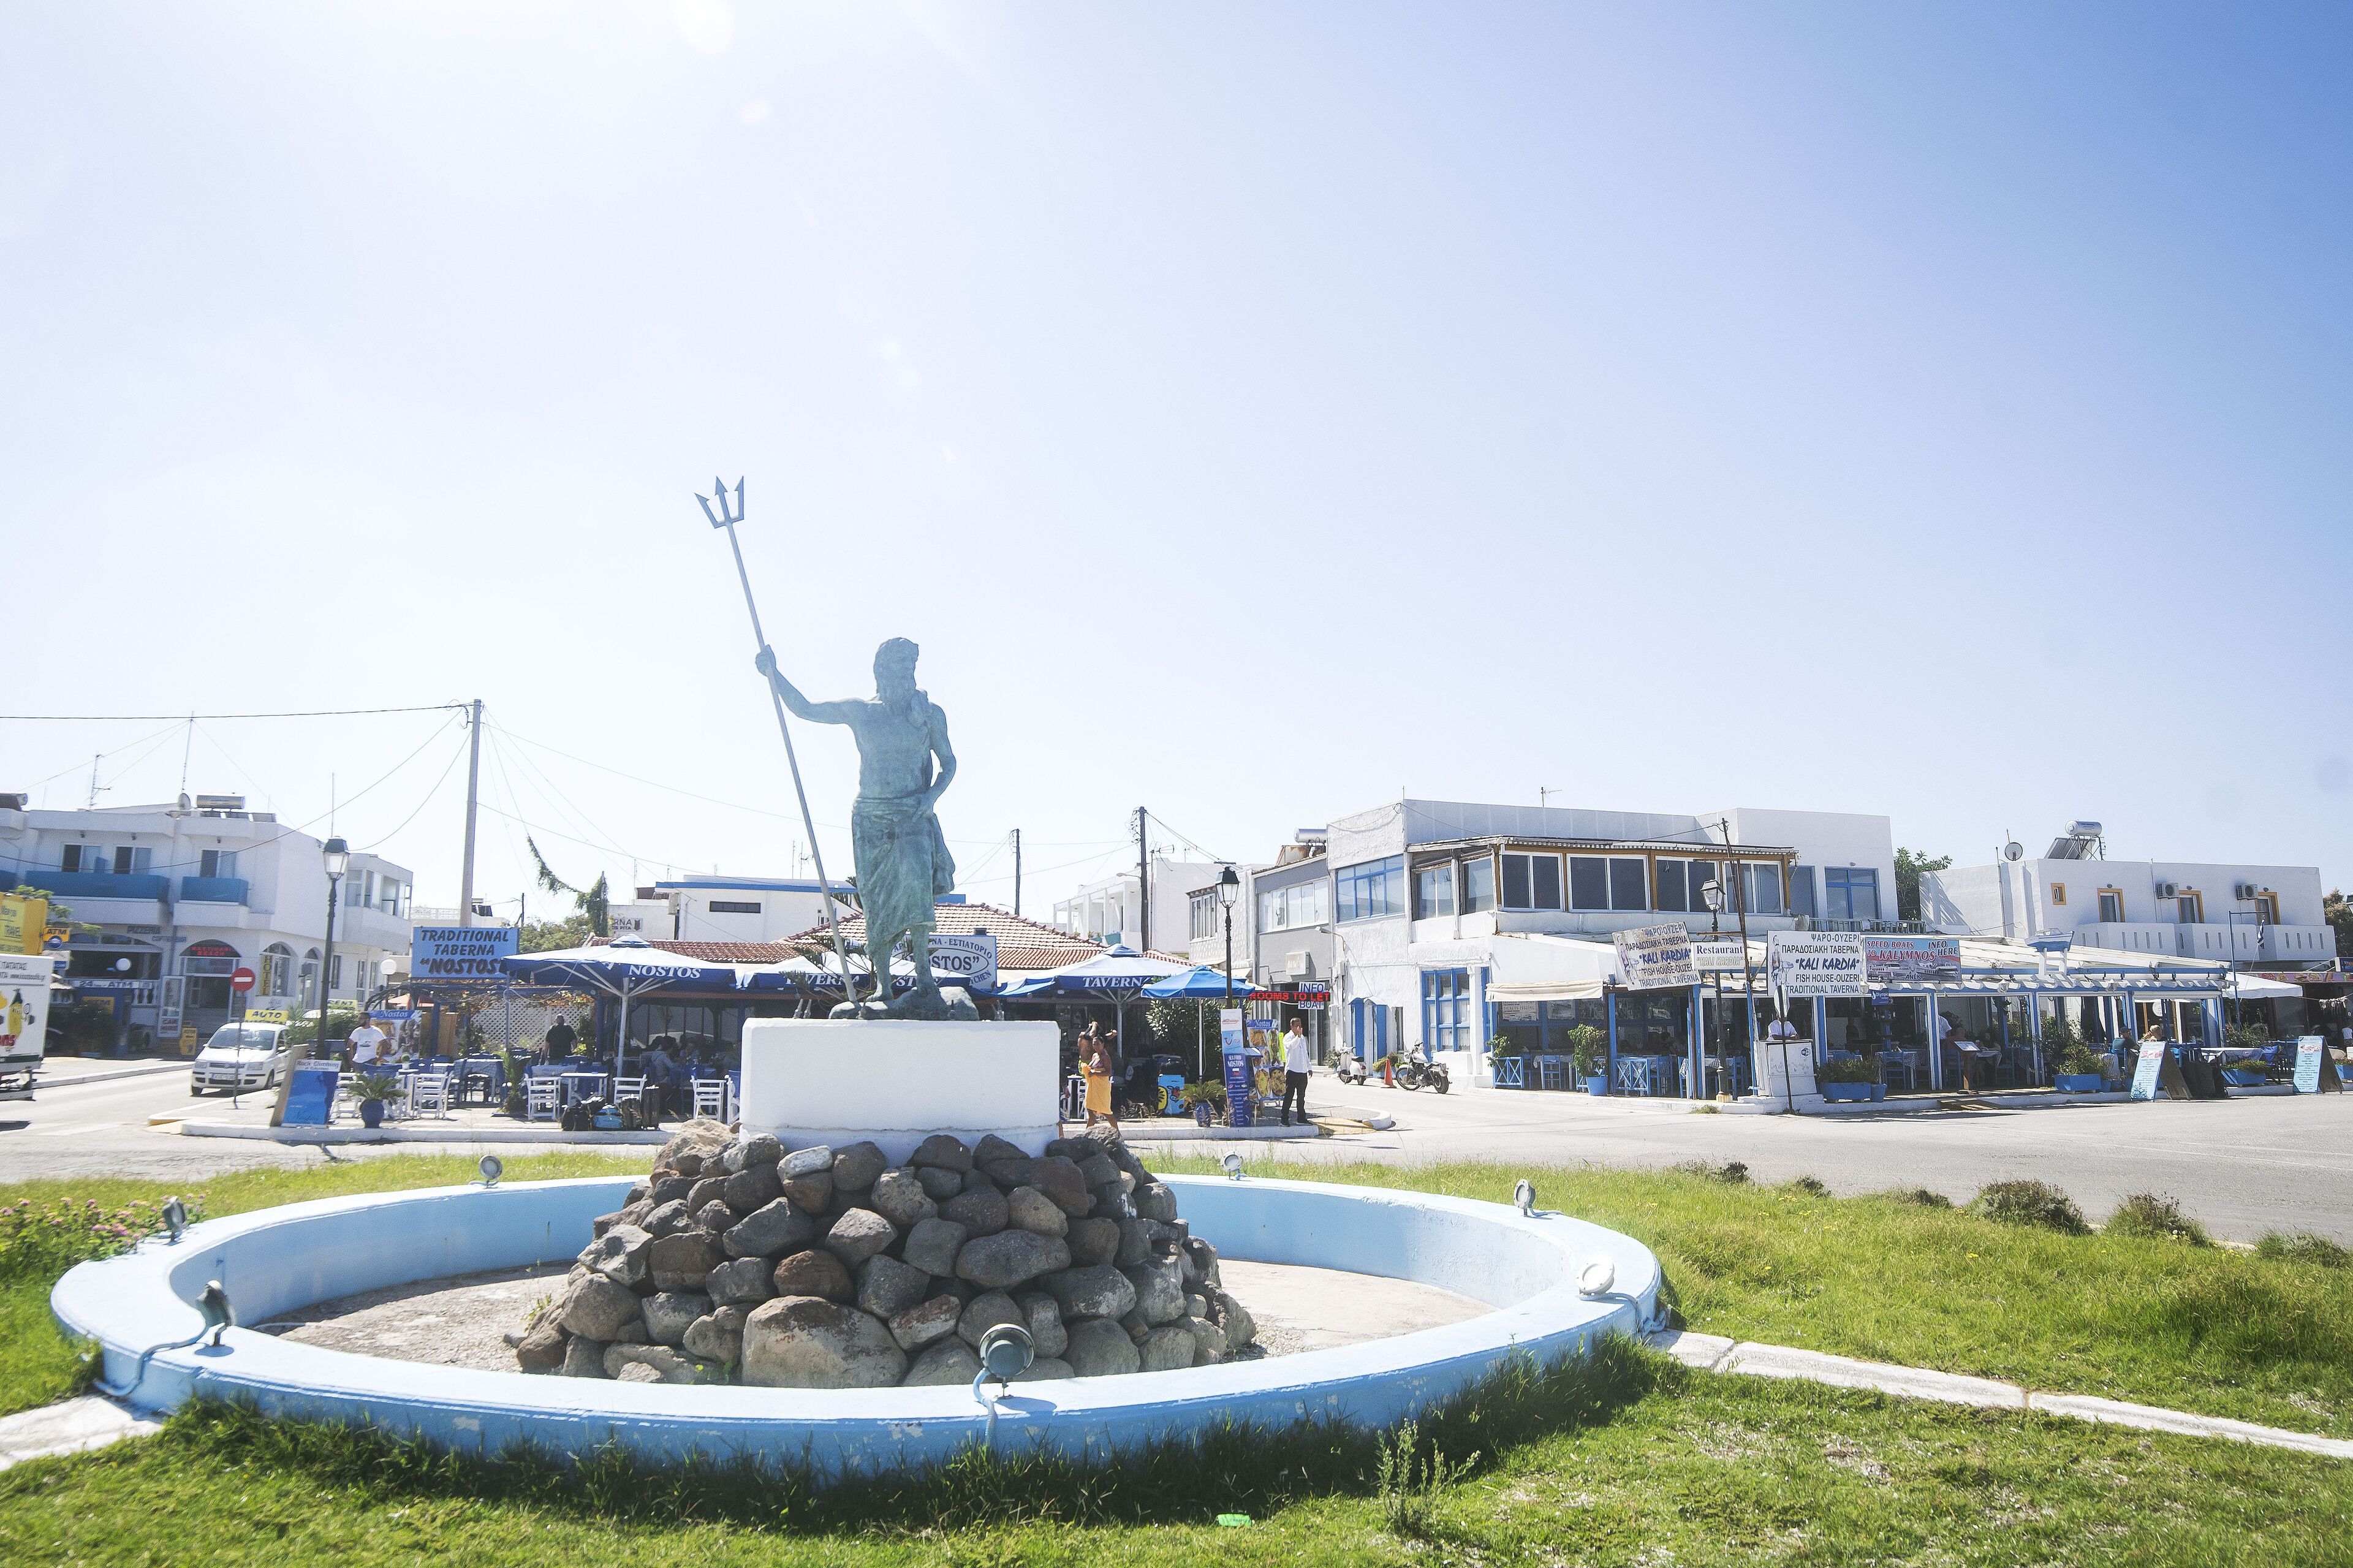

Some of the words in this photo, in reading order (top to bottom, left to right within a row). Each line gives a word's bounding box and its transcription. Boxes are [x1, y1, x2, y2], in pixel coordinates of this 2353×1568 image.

[421, 930, 509, 942] TRADITIONAL
[1811, 933, 1859, 942] ΨΑΡΟ-ΟΥΖΕΡΙ
[1625, 941, 1662, 951] ΠΑΡΑΔΟΣΙΑΚΗ
[1662, 936, 1688, 947] ΤΑΒΕΡΝΑ
[1928, 940, 1947, 950] INFO
[433, 944, 495, 956] TABERNA
[1697, 945, 1743, 954] Restaurant
[1782, 944, 1828, 953] ΠΑΡΑΔΟΣΙΑΚΗ
[1830, 945, 1859, 954] ΤΑΒΕΡΝΑ
[1938, 947, 1958, 957] HERE
[1879, 950, 1935, 961] KALYMNOS
[628, 964, 702, 979] NOSTOS
[1643, 967, 1655, 976] FISH
[1083, 976, 1150, 988] TAVERN
[1639, 977, 1673, 988] TRADITIONAL
[1673, 973, 1700, 984] TAVERNA
[1795, 974, 1811, 982] FISH
[1812, 974, 1859, 982] HOUSE-OUZERI
[1300, 983, 1324, 993] INFO
[1786, 985, 1828, 994] TRADITIONAL
[1830, 985, 1859, 993] TAVERNA
[1293, 992, 1307, 1001] TO
[1310, 993, 1330, 1002] LET
